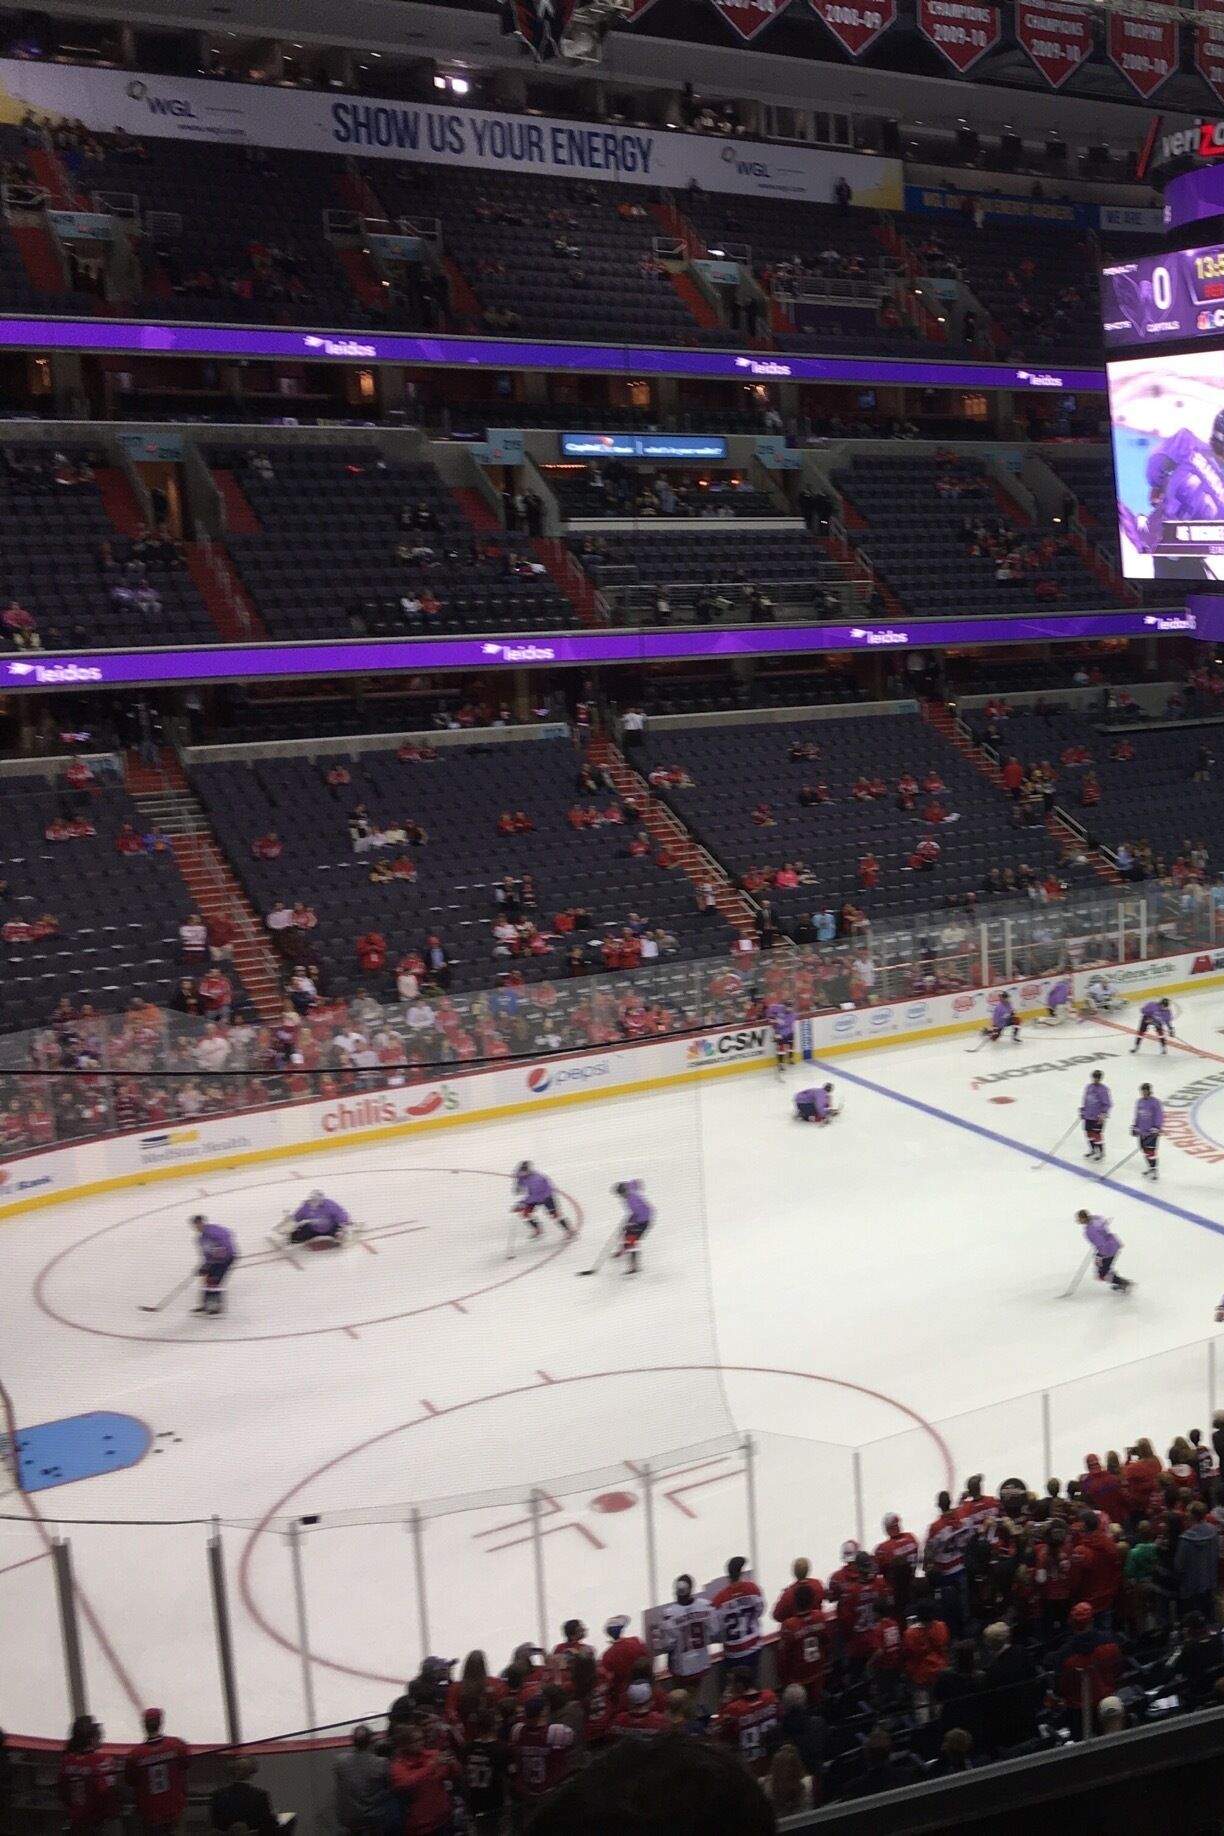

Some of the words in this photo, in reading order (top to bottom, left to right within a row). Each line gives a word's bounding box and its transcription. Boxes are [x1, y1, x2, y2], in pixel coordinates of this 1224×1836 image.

[147, 97, 198, 118] WGL
[332, 102, 421, 150] SHOW
[427, 112, 466, 155] US
[470, 116, 546, 163] YOUR
[550, 125, 655, 174] ENERGY
[1152, 266, 1172, 310] 0
[325, 341, 376, 357] leidos
[751, 361, 792, 376] leidos
[1029, 374, 1063, 387] leidos
[866, 632, 908, 646] leidos
[502, 645, 555, 660] leidos
[35, 663, 102, 682] leidos
[717, 1028, 765, 1055] CSN
[553, 1060, 610, 1086] pepsi
[980, 1052, 1120, 1085] verizon
[321, 1096, 398, 1133] chili's
[724, 1605, 757, 1643] 27
